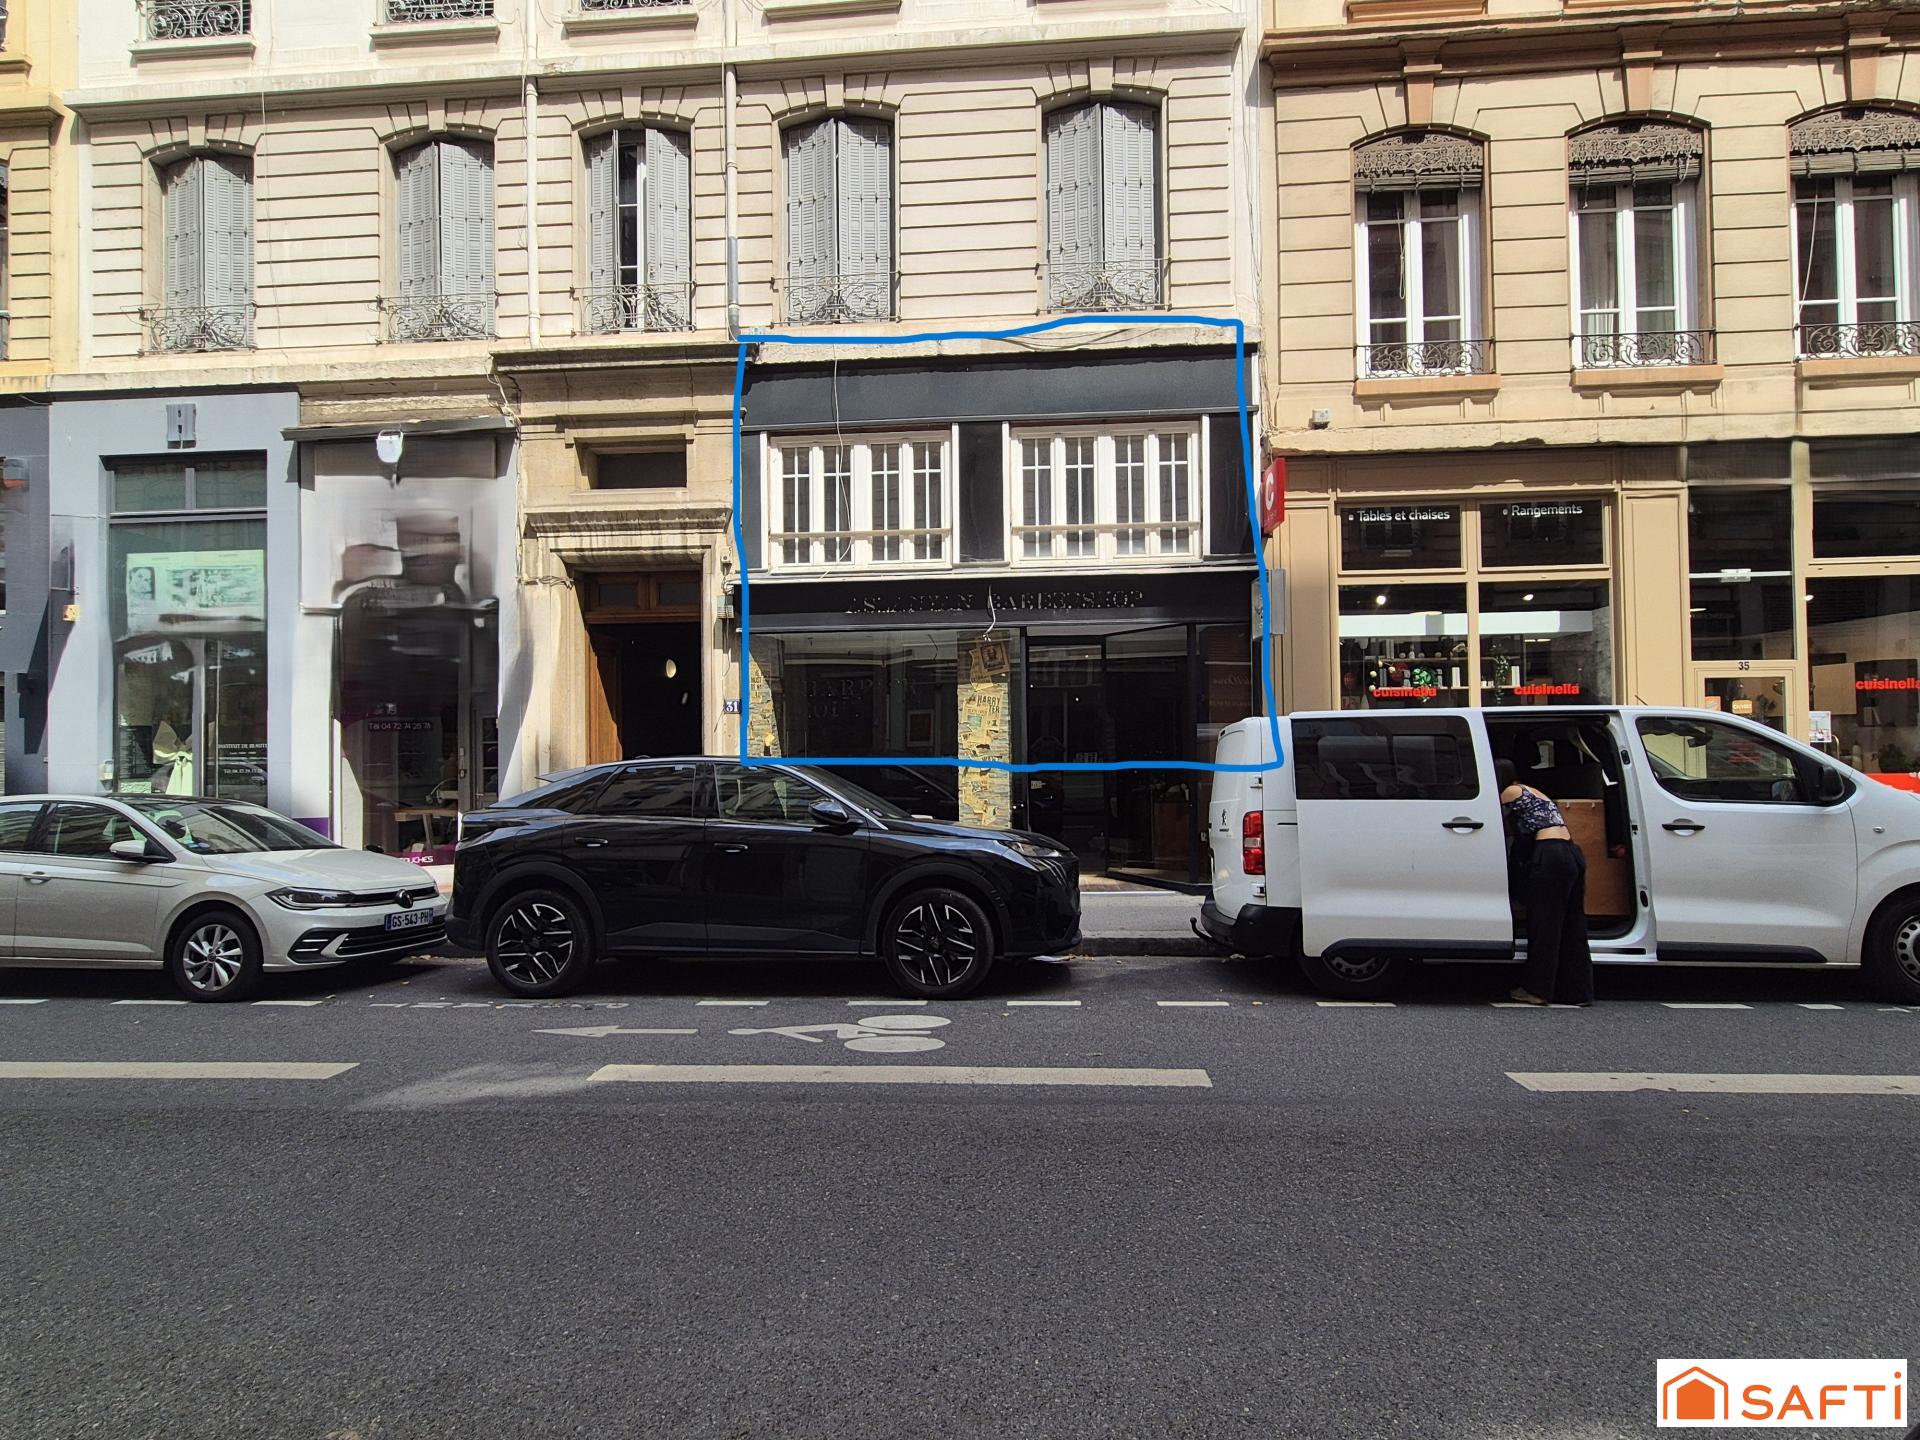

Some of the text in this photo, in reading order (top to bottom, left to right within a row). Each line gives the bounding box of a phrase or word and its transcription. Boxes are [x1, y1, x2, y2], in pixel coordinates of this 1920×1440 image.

[1265, 472, 1274, 511] C
[1357, 509, 1450, 522] Tables et chaises
[1511, 503, 1584, 517] Rangements
[1738, 661, 1750, 671] 35
[1373, 687, 1438, 698] cuisinella
[1513, 683, 1580, 695] cuisinella
[978, 695, 1000, 705] HARRY
[725, 701, 739, 712] 31
[392, 911, 430, 928] GS-543-PH
